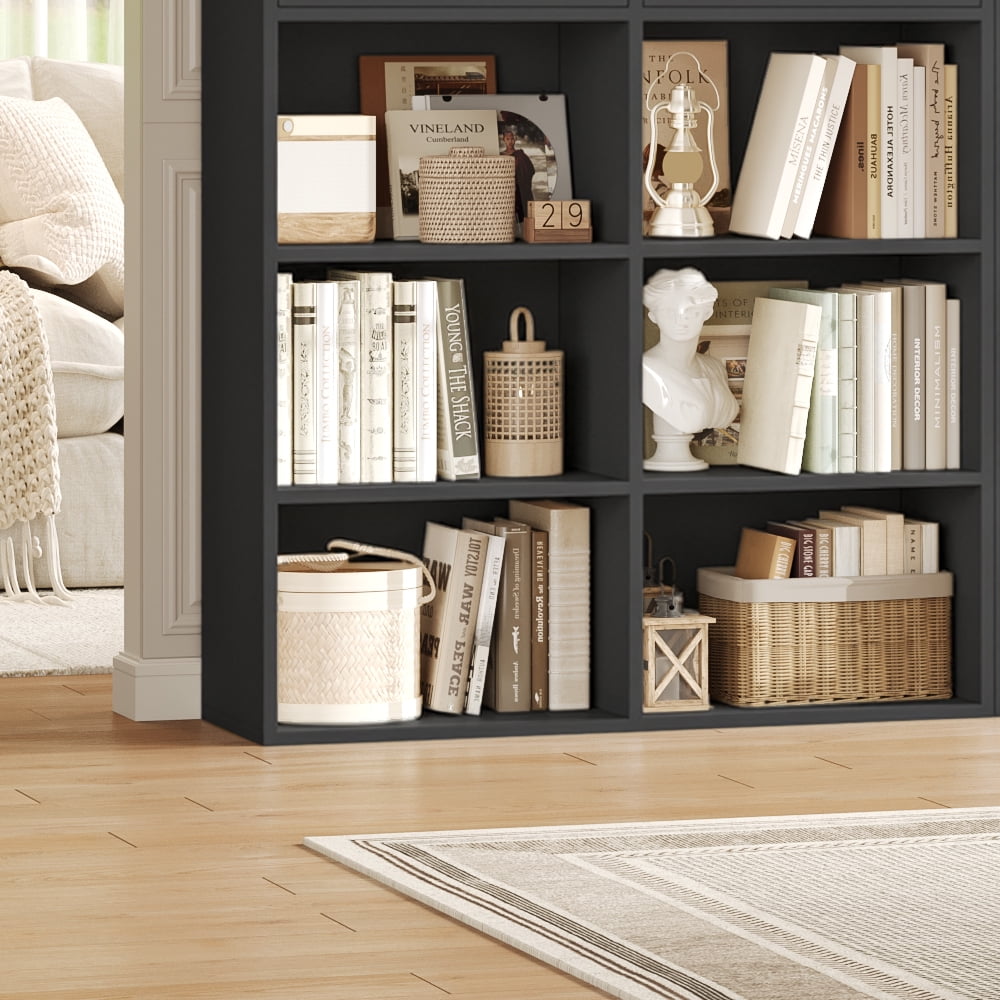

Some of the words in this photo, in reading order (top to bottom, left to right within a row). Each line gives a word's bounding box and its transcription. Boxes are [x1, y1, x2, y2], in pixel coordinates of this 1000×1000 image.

[808, 86, 829, 143] MACARONS
[825, 103, 841, 139] JUSTICE
[409, 123, 485, 134] VINELAND
[788, 116, 810, 168] MISENA
[818, 140, 831, 162] THIN
[813, 162, 825, 183] THE
[732, 298, 752, 308] OF
[445, 303, 464, 353] YOUNG
[448, 365, 468, 393] THE
[934, 325, 942, 429] MINIMALISM
[452, 396, 473, 442] SHACK
[803, 533, 814, 545] BIG
[818, 533, 830, 544] BIG
[803, 545, 814, 564] STONE
[818, 545, 830, 568] CHERRY
[803, 565, 814, 577] GAP
